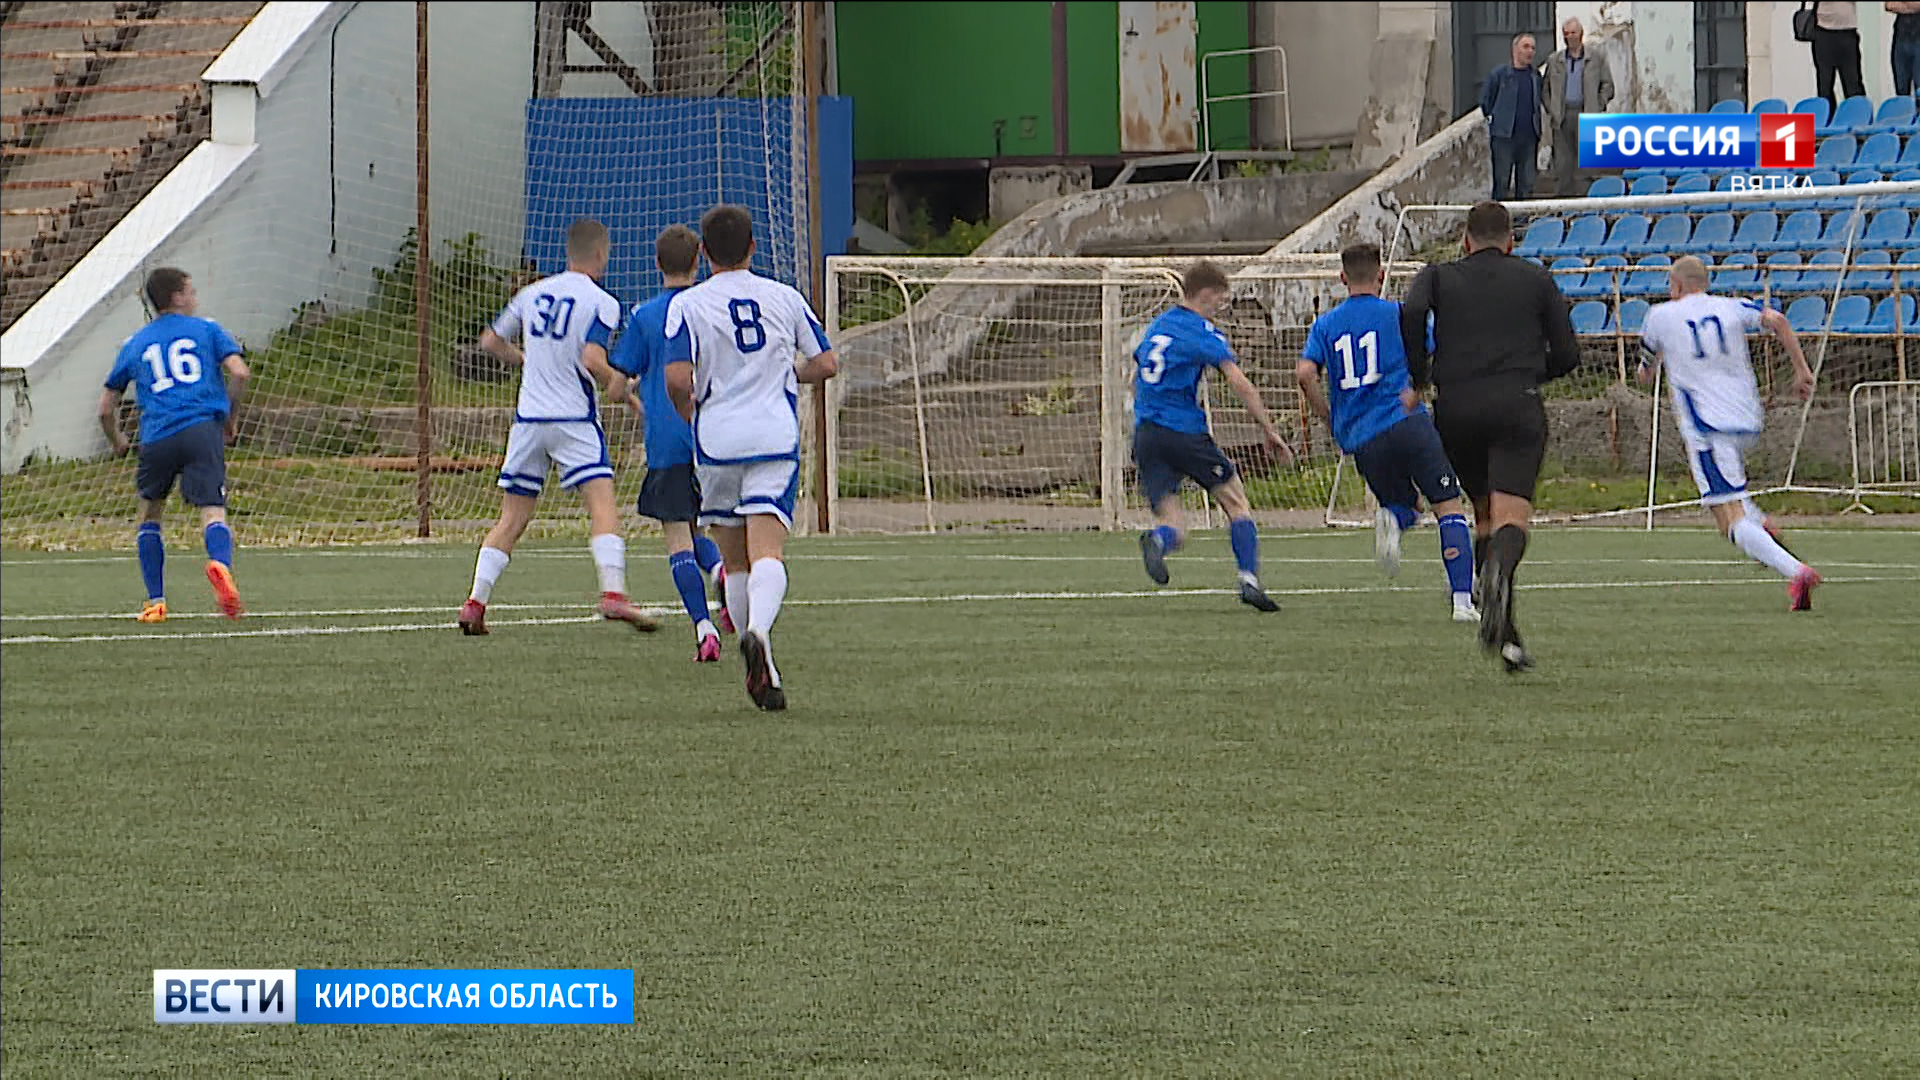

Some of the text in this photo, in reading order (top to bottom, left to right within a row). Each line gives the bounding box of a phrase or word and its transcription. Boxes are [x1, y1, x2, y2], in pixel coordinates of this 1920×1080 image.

[530, 294, 577, 340] 30
[727, 298, 767, 354] 8
[1686, 315, 1730, 359] 17
[141, 338, 203, 394] 16
[1140, 335, 1172, 385] 3
[1334, 330, 1383, 391] 11
